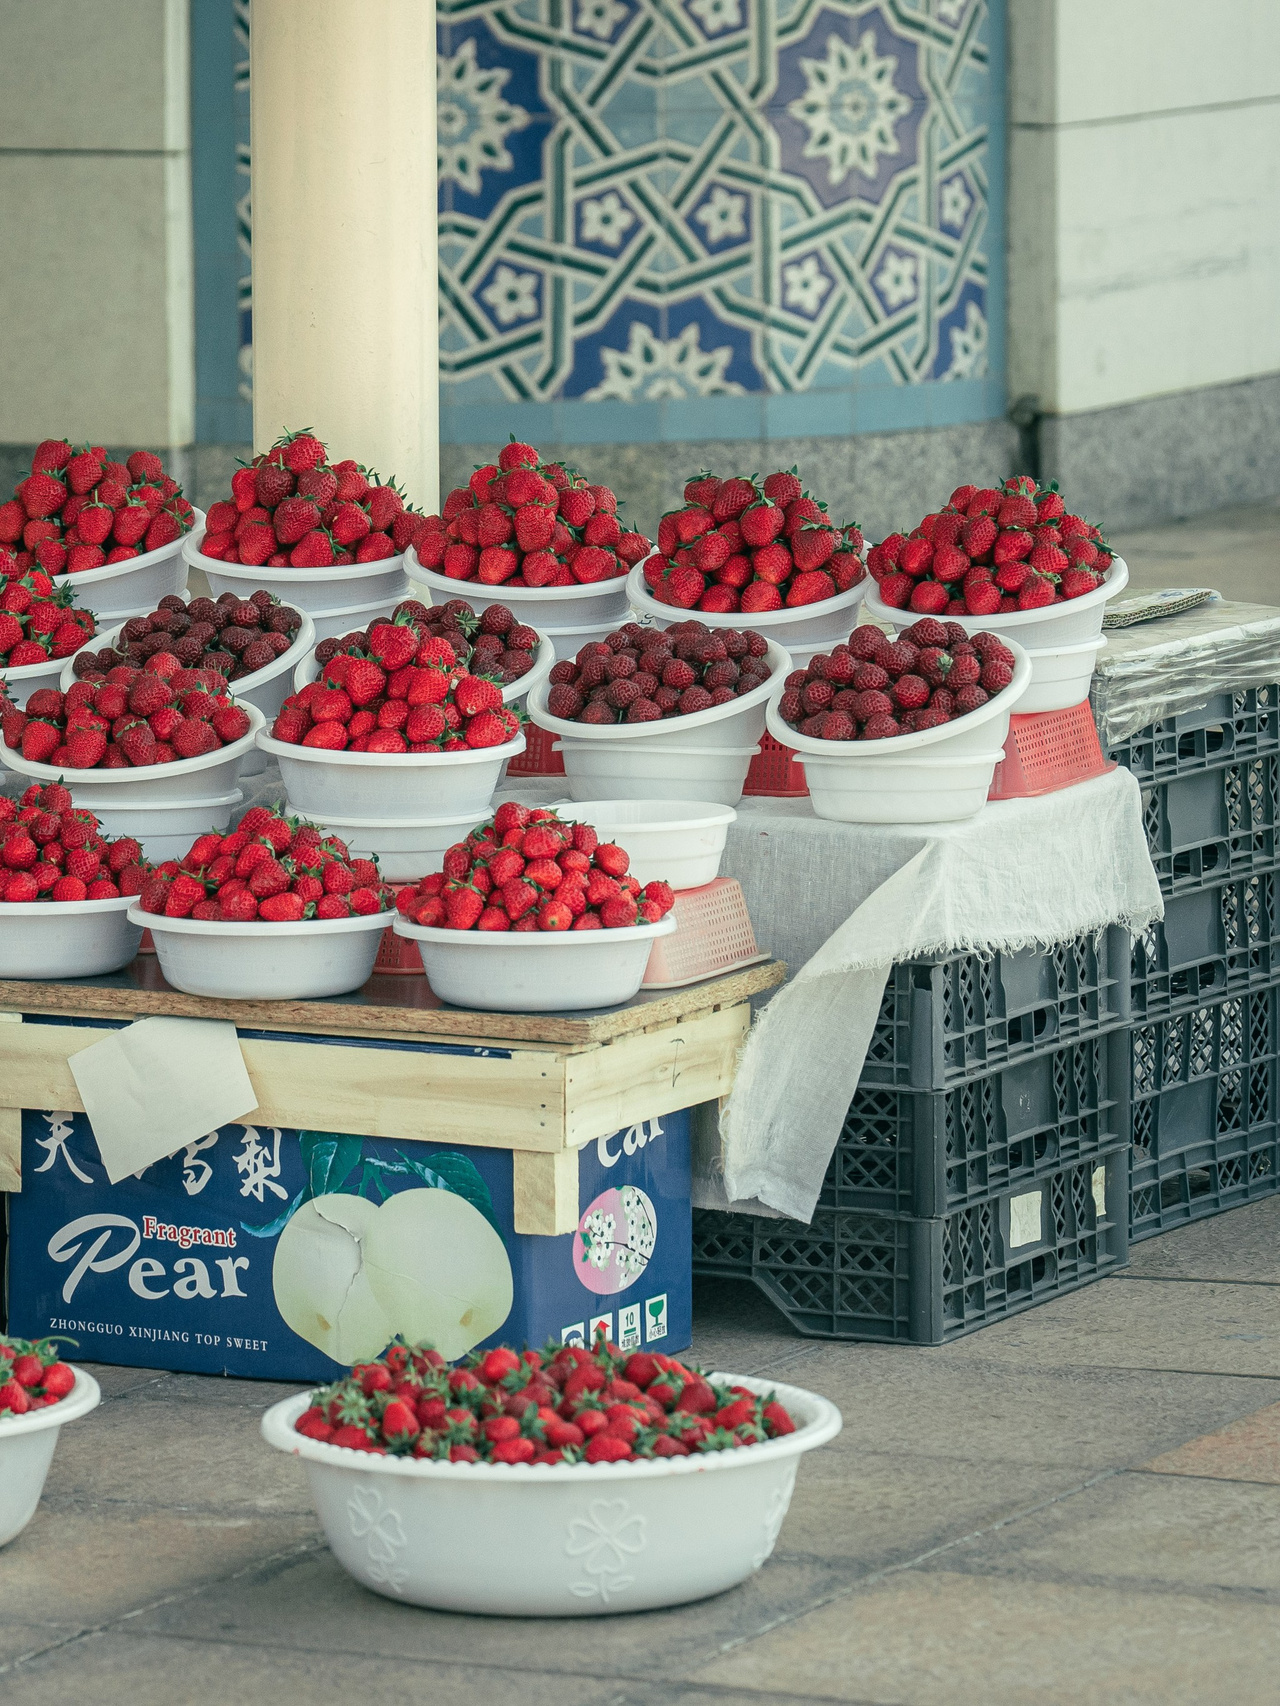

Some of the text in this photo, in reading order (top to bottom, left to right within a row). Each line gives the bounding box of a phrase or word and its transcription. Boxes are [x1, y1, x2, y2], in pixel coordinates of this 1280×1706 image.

[142, 1215, 237, 1248] Fragrant
[48, 1213, 250, 1304] Pear
[49, 1317, 268, 1351] ZHONGGUO XINJIANG TOP SWEET
[625, 1311, 635, 1327] 10
